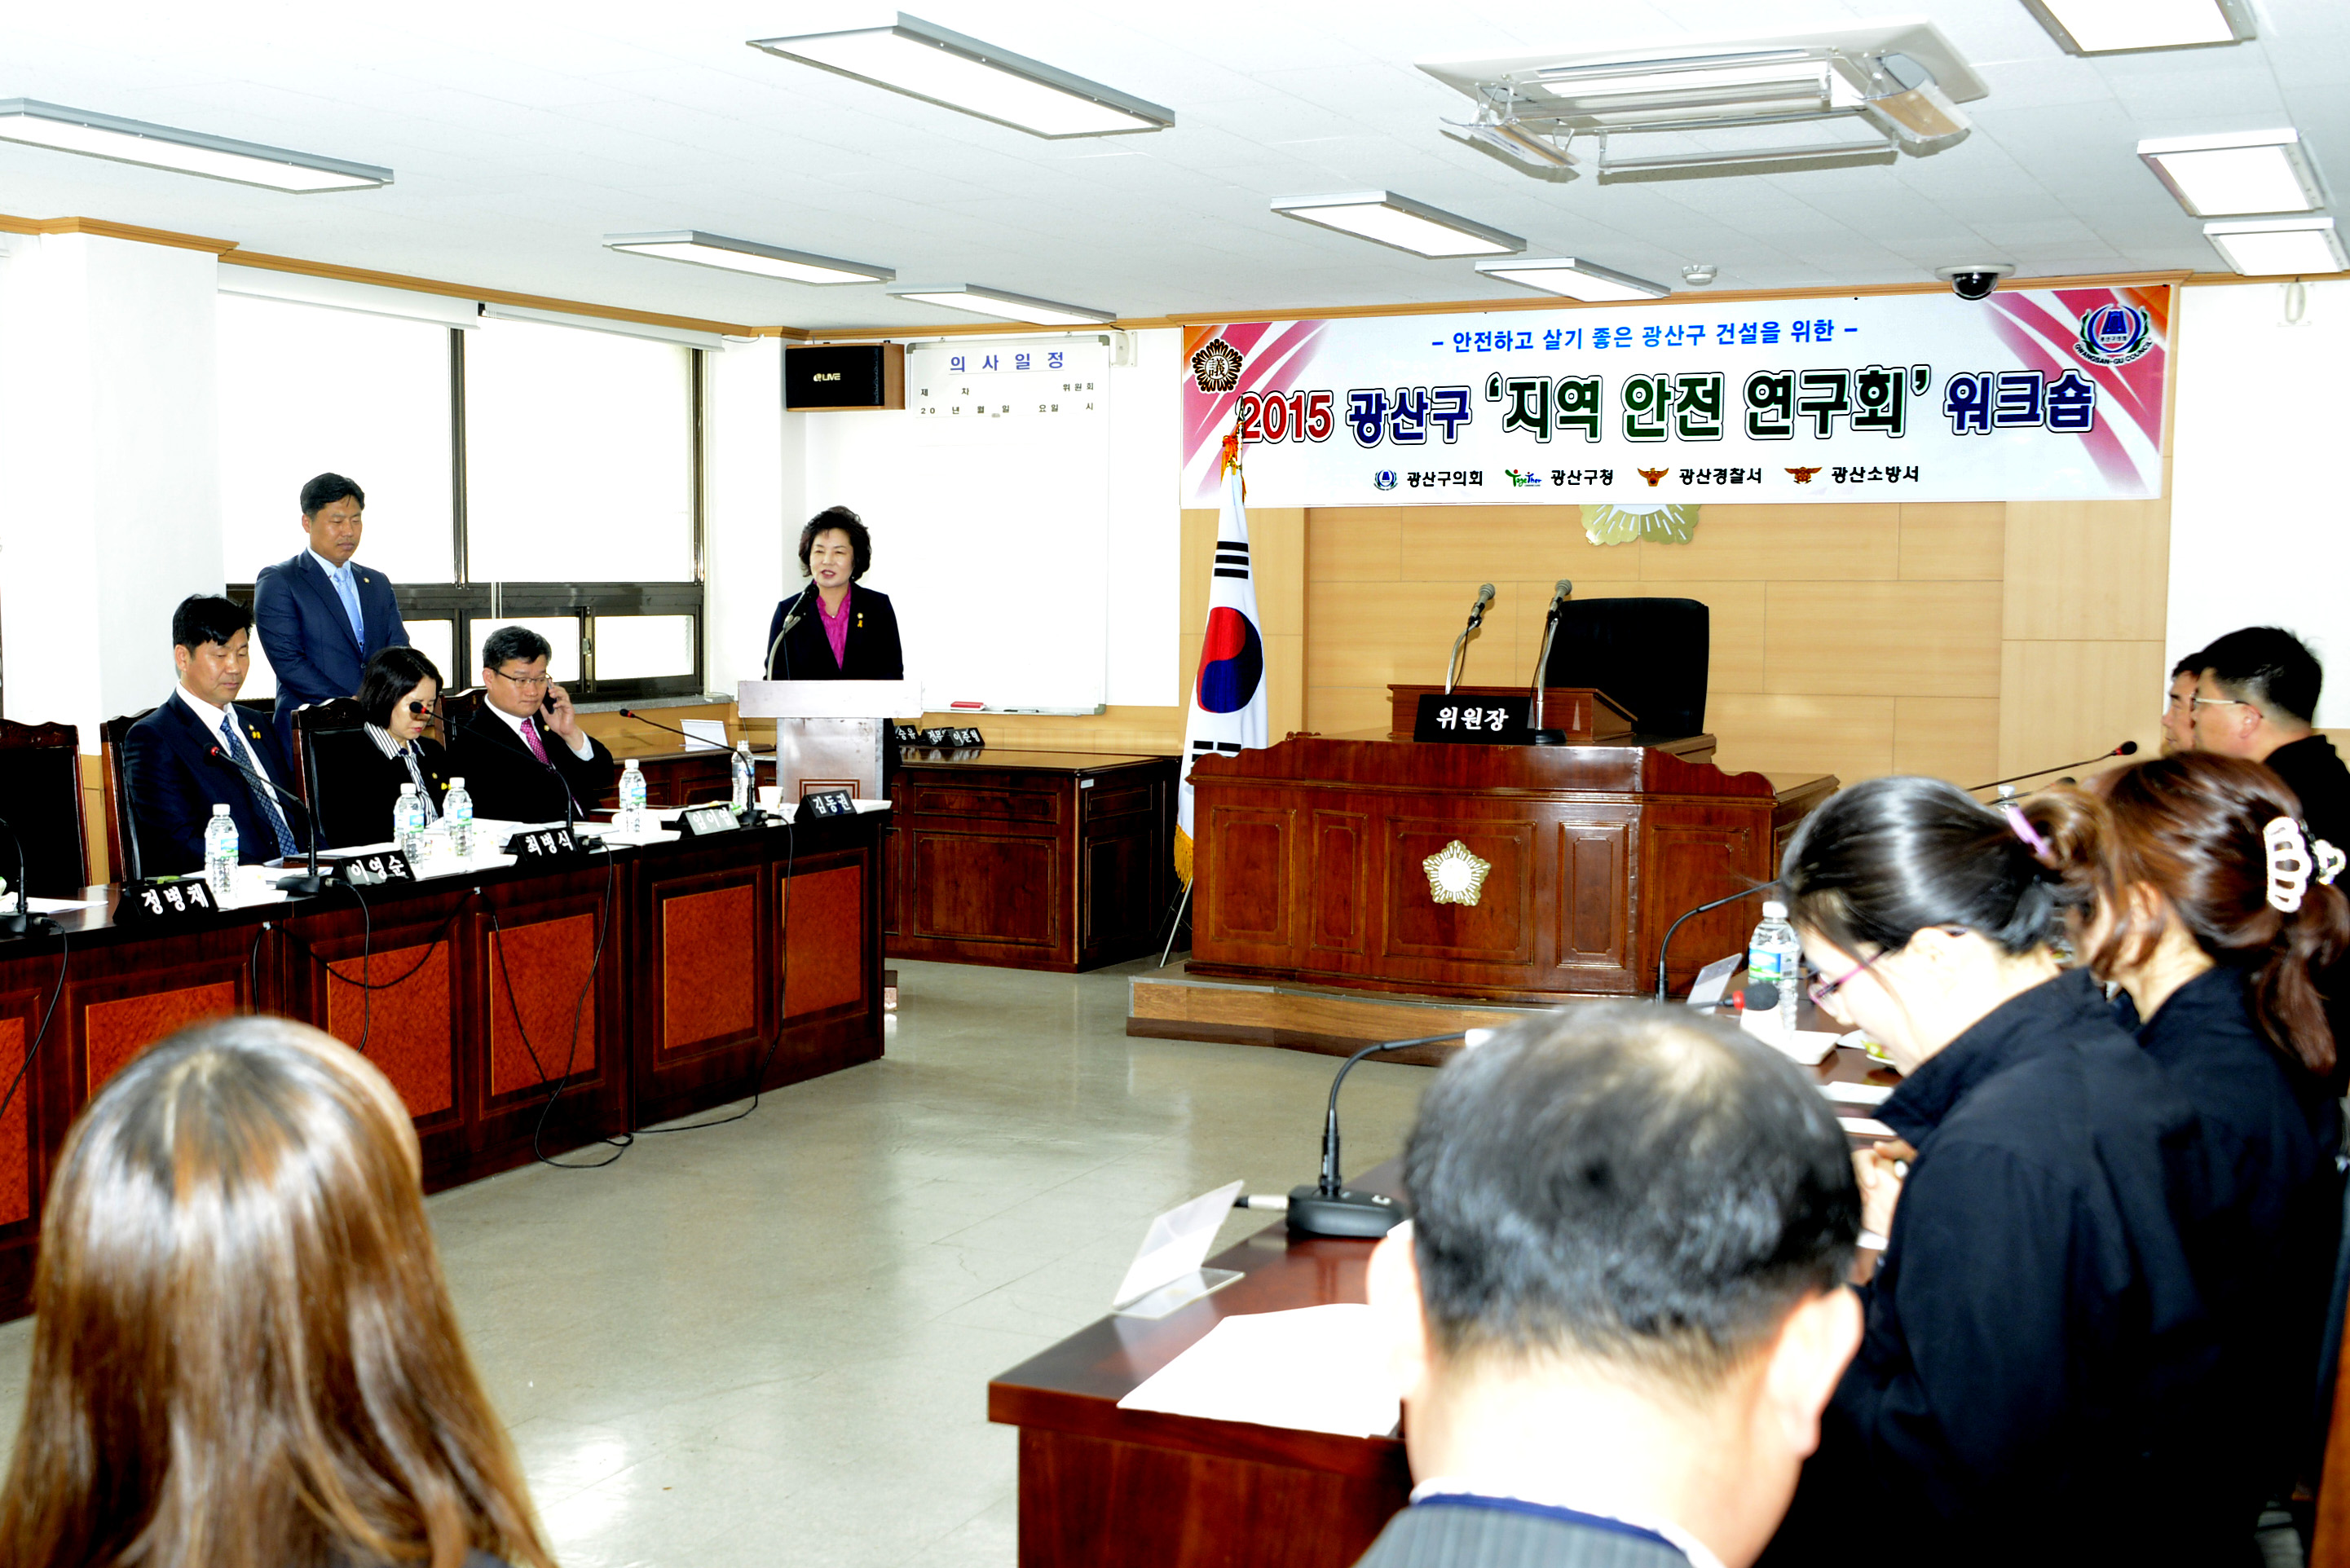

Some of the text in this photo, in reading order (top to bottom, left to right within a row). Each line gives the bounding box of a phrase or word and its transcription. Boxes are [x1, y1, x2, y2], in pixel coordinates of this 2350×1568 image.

[1453, 329, 1535, 354] 안전하고
[1542, 328, 1583, 351] 살기
[1592, 326, 1634, 350] 좋은
[1642, 324, 1707, 348] 광산구
[1716, 320, 1782, 346] 건설을
[1790, 319, 1836, 343] 위한
[1238, 367, 2094, 444] 2015 광산구 ‘지역 안전 연구회’ 워크숍
[1406, 469, 1484, 488] 광산구의회
[1550, 469, 1614, 487] 광산구청
[1679, 467, 1761, 486] 광산경찰서
[1831, 465, 1919, 484] 광산소방서
[1435, 706, 1510, 732] 위원장
[895, 727, 916, 741] 승유
[525, 830, 574, 857] 최병식
[351, 855, 407, 883] 이영순
[140, 883, 209, 914] 정병채
